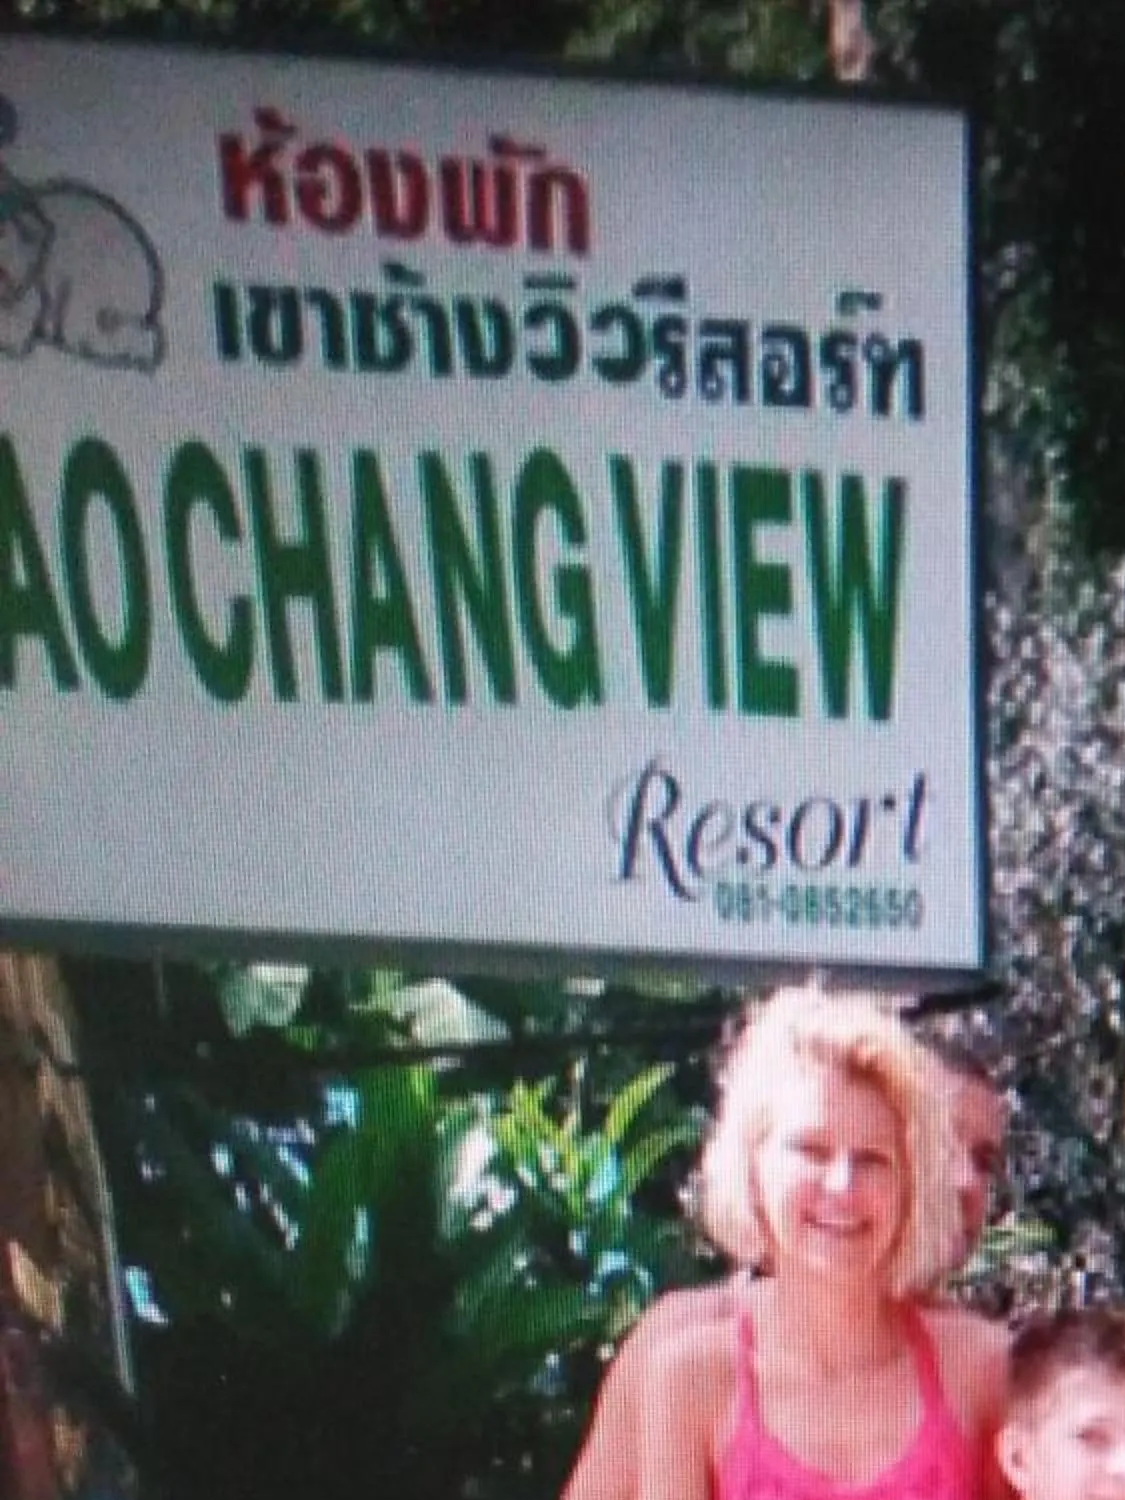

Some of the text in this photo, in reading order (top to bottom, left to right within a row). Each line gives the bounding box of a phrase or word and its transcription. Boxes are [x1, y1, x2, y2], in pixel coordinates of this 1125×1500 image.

[219, 106, 592, 258] ห้องพัก
[608, 454, 908, 721] VIEW
[607, 757, 930, 902] Resort
